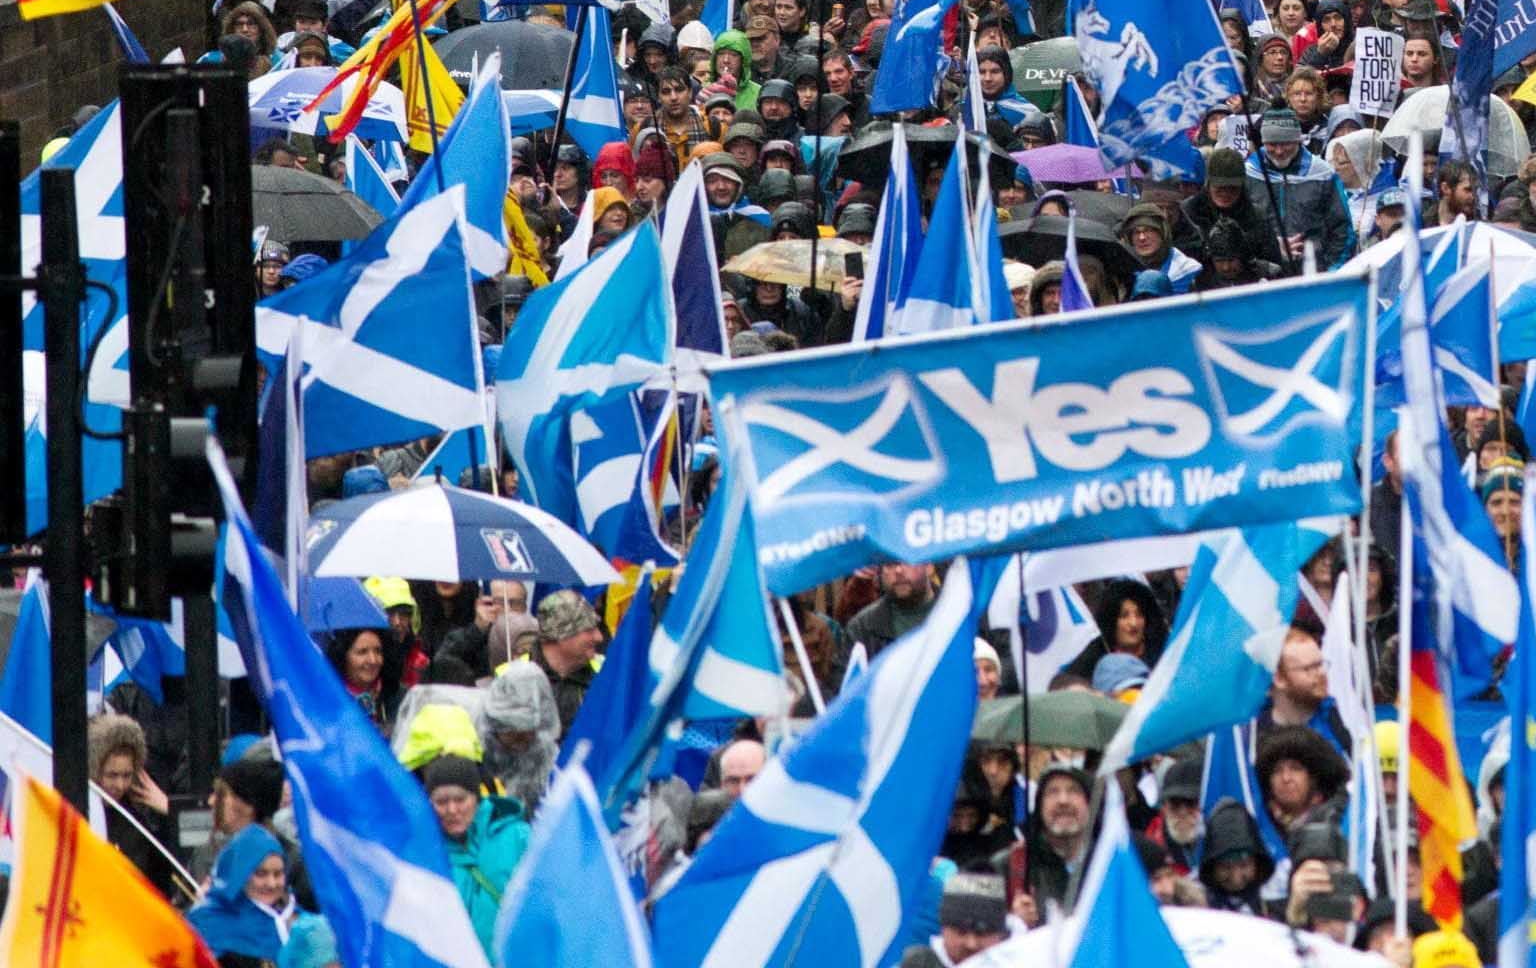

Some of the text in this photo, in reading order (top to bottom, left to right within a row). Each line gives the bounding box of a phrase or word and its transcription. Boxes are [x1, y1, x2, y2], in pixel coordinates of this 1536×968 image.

[1364, 36, 1393, 57] END
[1360, 58, 1397, 80] TORY
[1360, 80, 1396, 102] RULE
[918, 357, 1212, 483] Yes
[905, 495, 1064, 548] Glasgow
[1072, 468, 1175, 518] North
